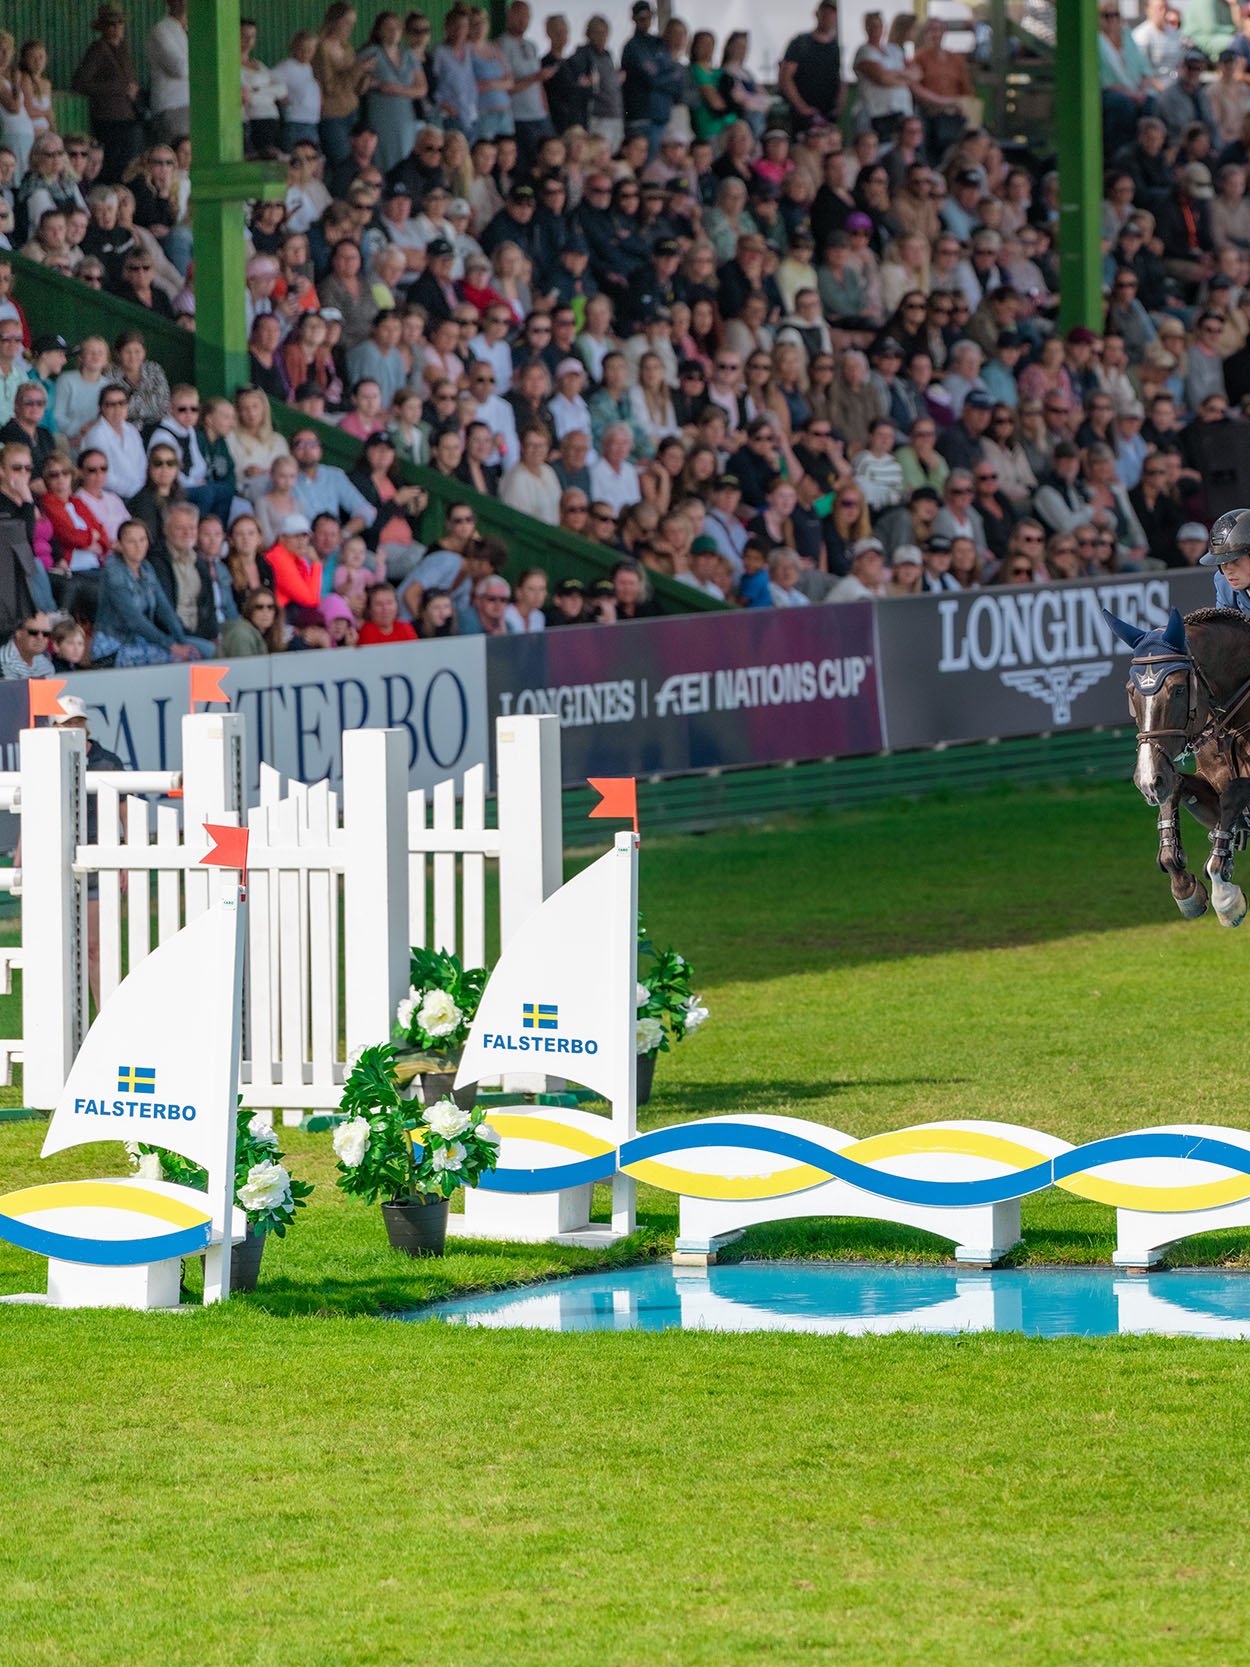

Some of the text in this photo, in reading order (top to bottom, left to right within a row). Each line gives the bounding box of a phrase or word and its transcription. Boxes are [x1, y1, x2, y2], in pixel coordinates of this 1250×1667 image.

[938, 580, 1172, 673] LONGINES
[714, 660, 817, 711] NATIONS
[483, 1033, 599, 1055] FALSTERBO
[74, 1098, 197, 1121] FALSTERBO
